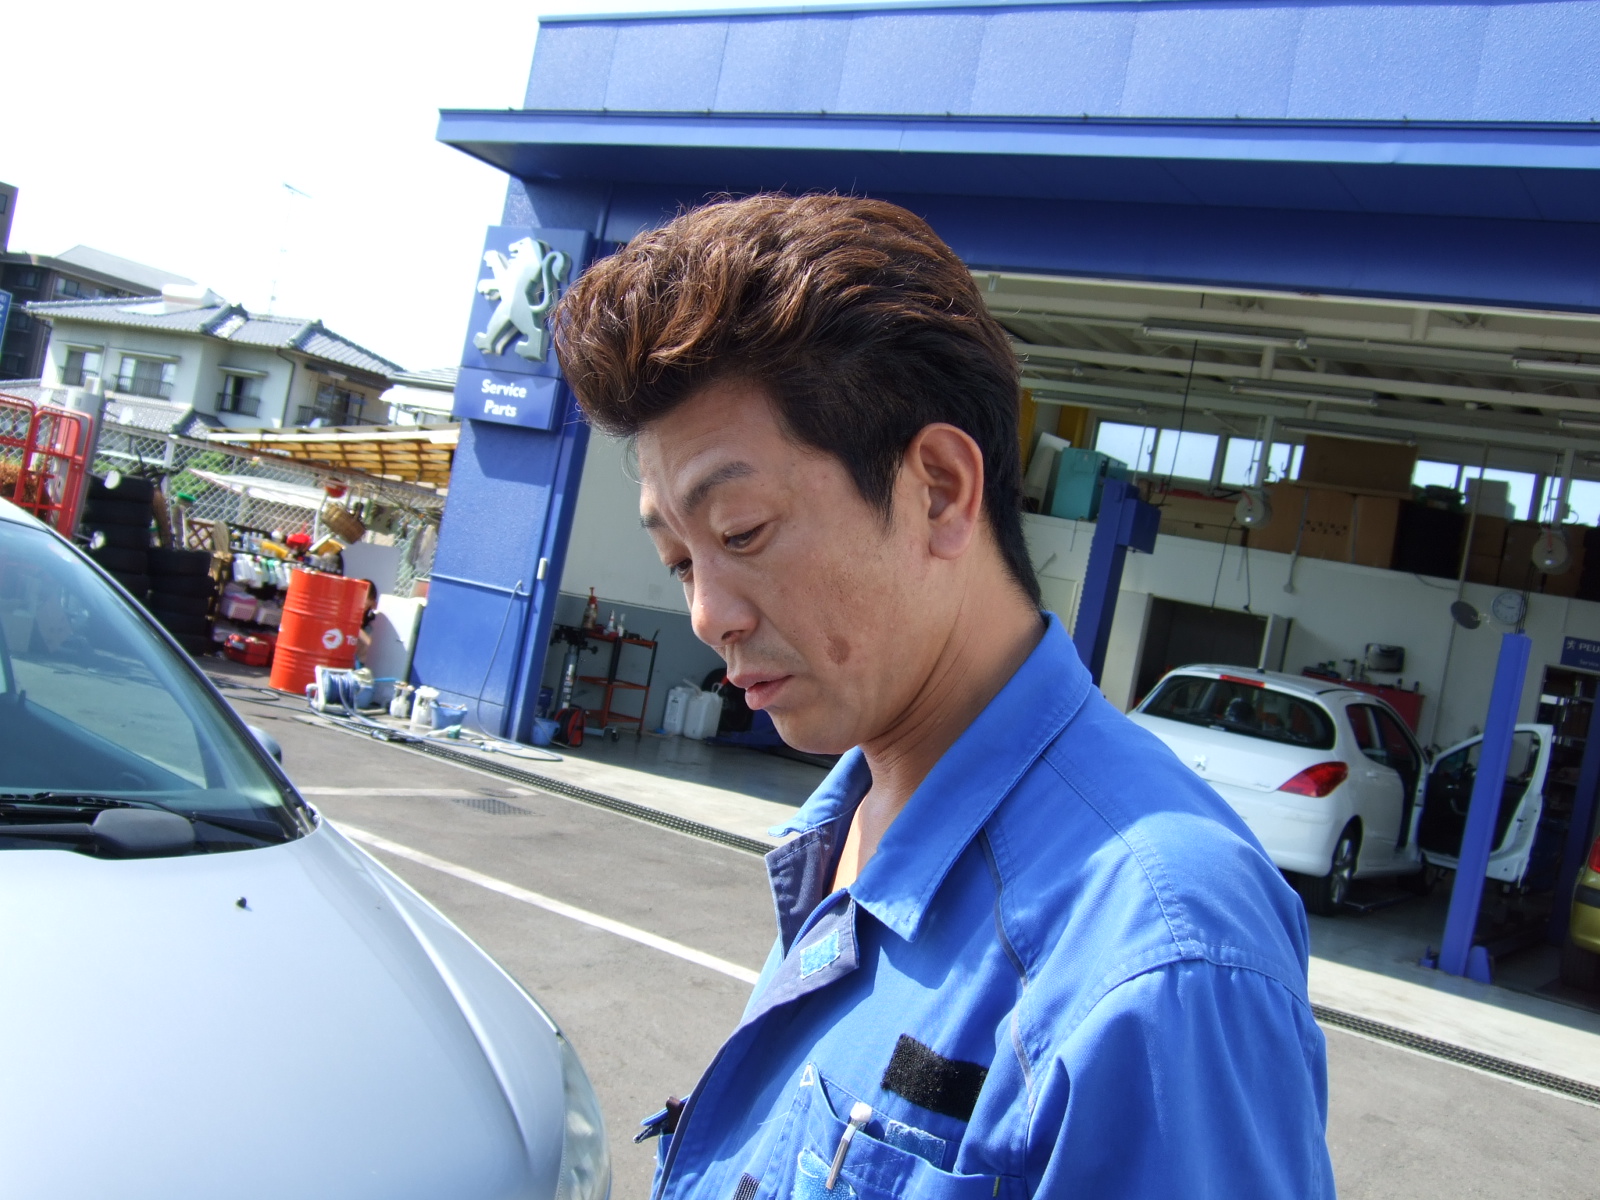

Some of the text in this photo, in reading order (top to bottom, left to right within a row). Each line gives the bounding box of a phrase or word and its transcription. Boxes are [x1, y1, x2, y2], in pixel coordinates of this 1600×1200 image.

[481, 379, 527, 398] Service
[483, 399, 517, 417] Parts
[345, 635, 358, 646] To
